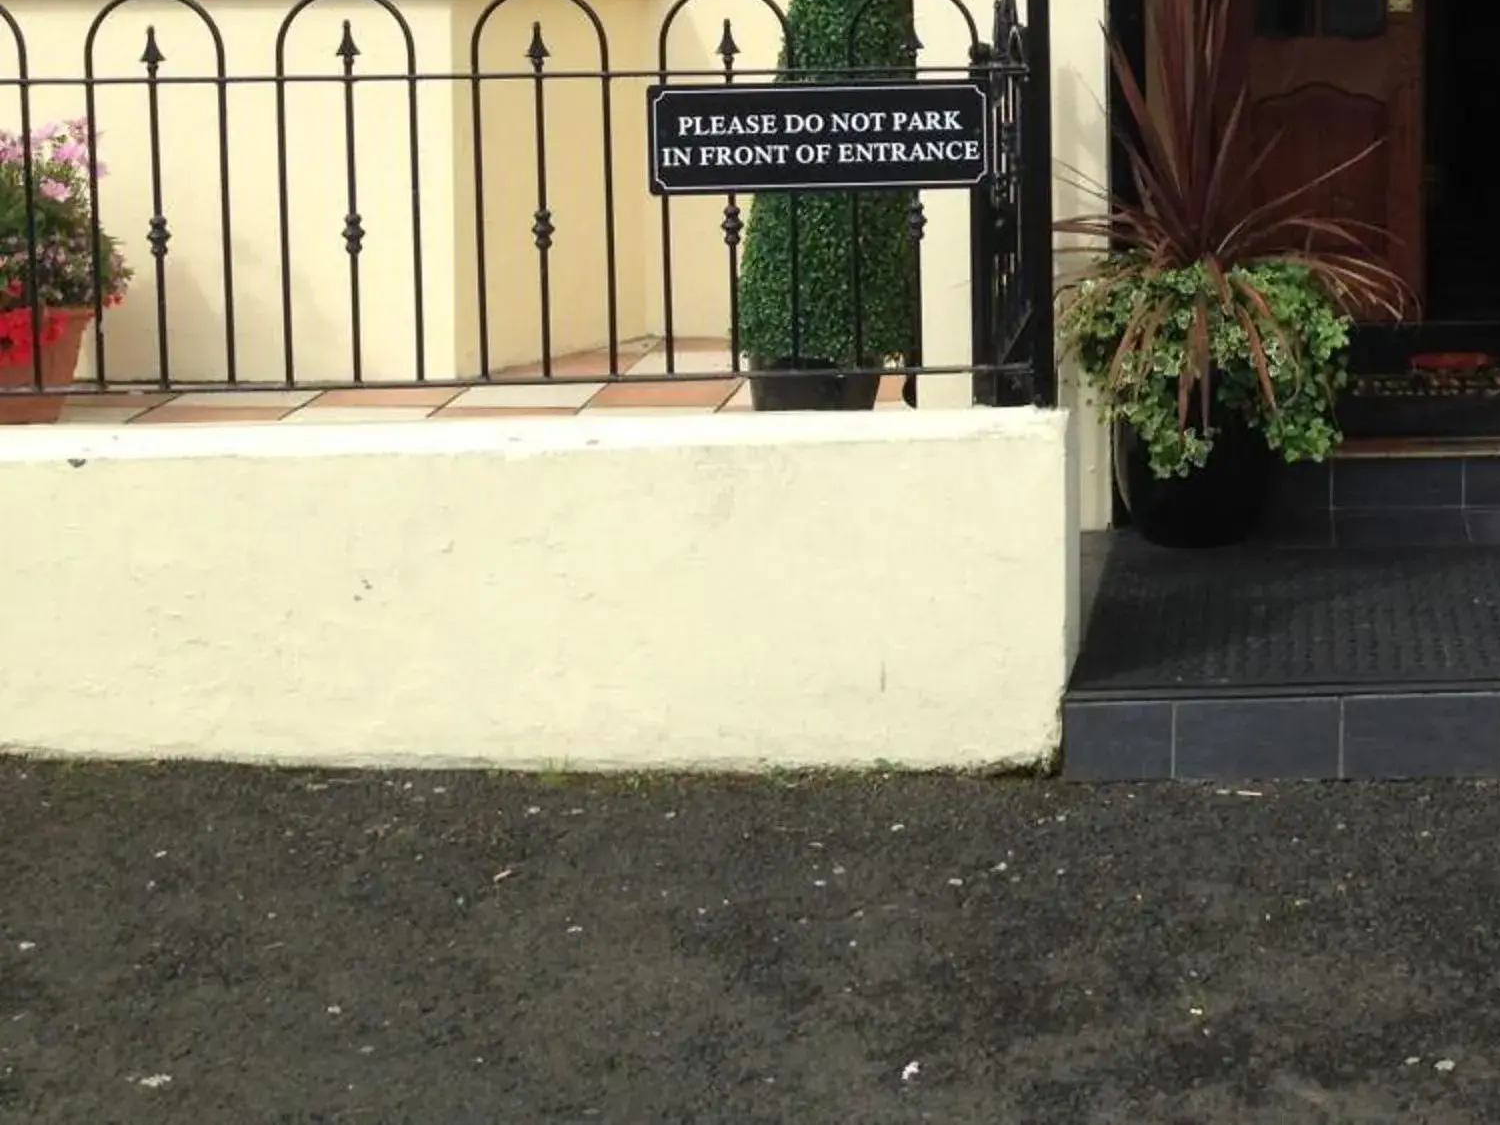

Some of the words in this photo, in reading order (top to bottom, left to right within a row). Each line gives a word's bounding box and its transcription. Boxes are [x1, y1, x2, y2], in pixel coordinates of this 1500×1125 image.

[678, 114, 777, 136] PLEASE
[785, 113, 824, 133] DO
[831, 112, 887, 132] NOT
[893, 110, 963, 131] PARK
[663, 147, 692, 167] IN
[700, 144, 788, 166] FRONT
[796, 143, 833, 164] OF
[839, 140, 980, 163] ENTRANCE
